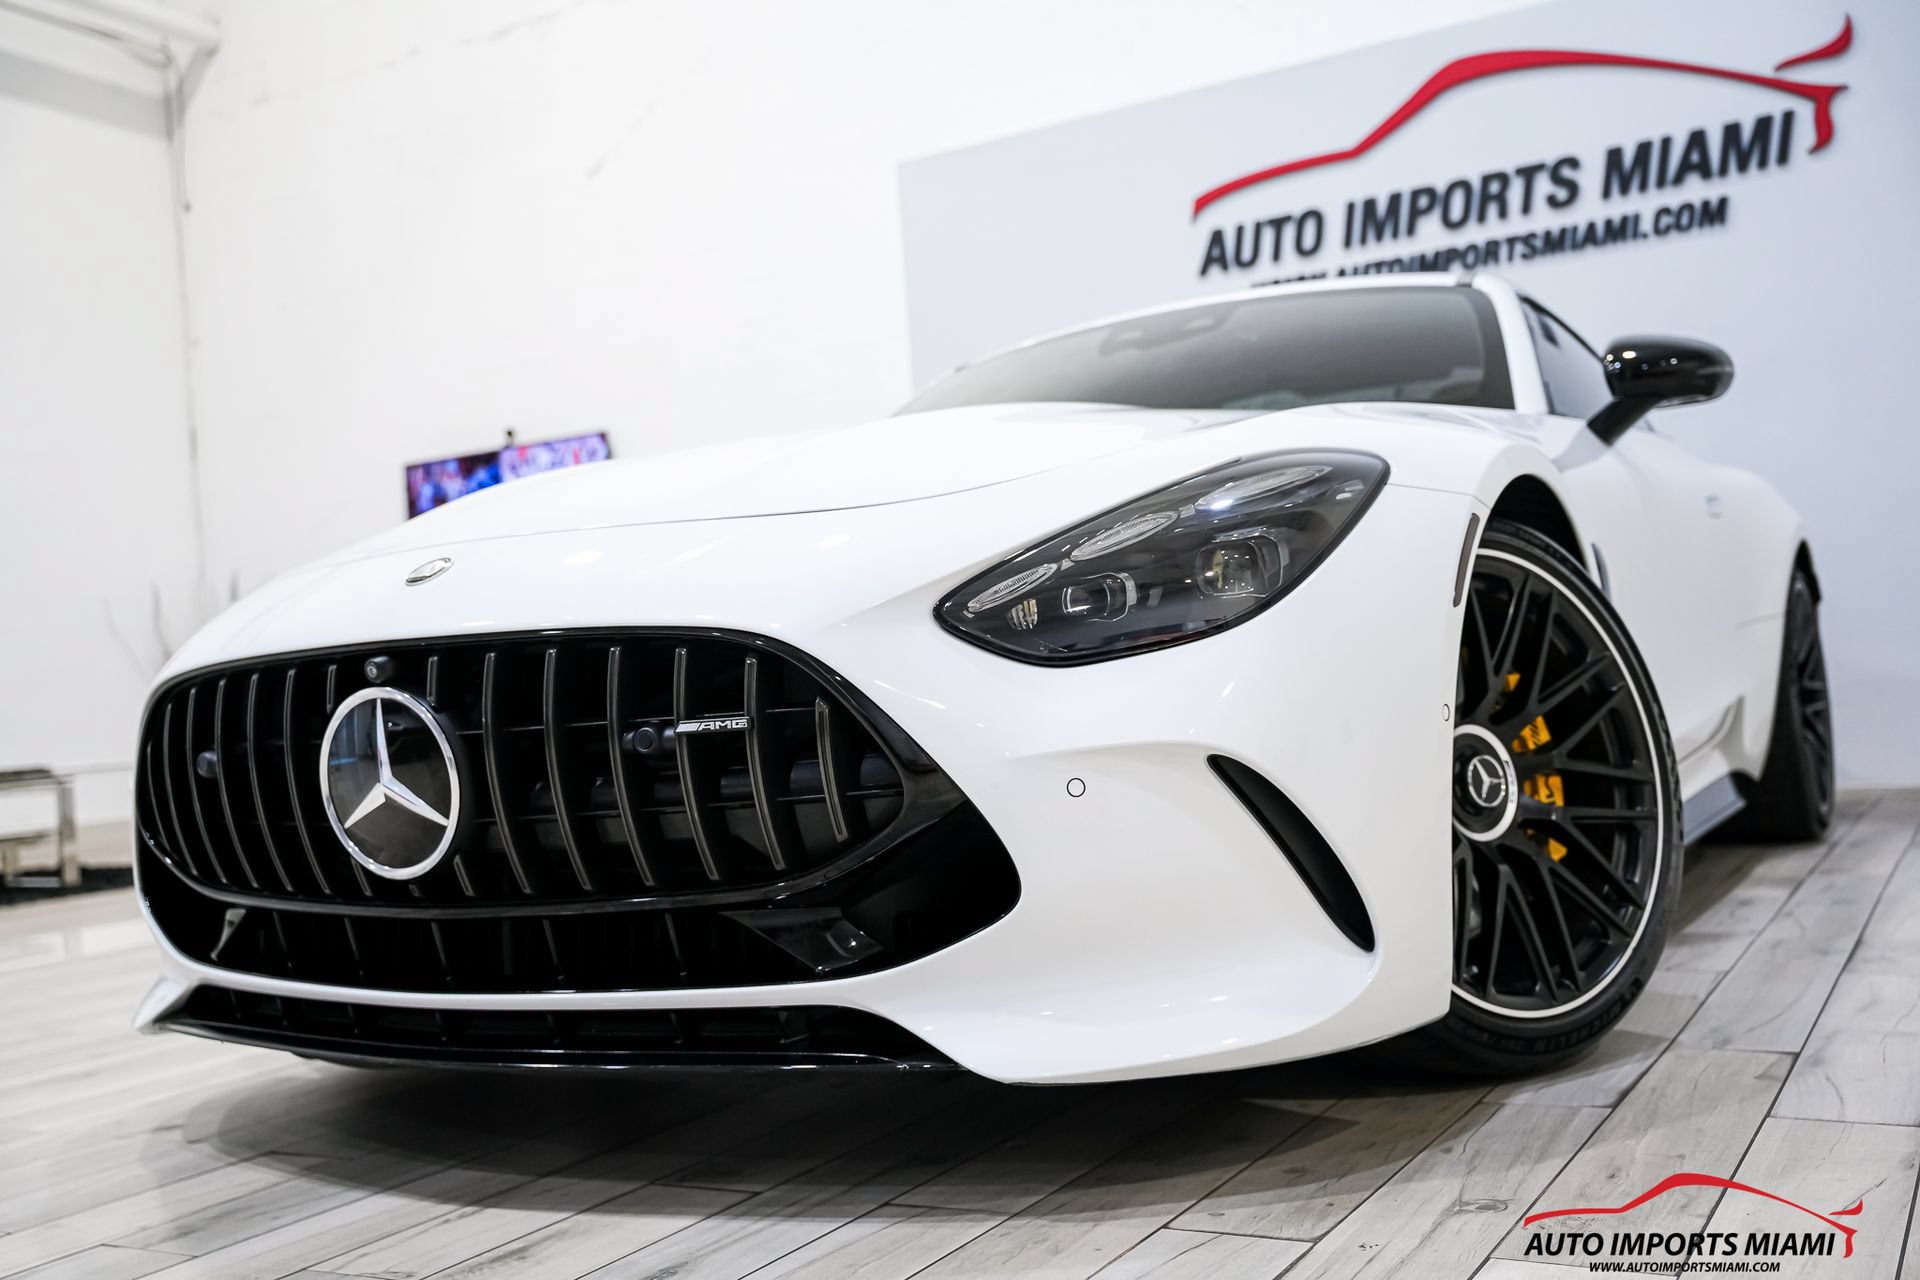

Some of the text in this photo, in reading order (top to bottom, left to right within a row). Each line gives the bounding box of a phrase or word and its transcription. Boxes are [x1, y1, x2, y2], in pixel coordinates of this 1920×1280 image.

[1200, 109, 1796, 277] AUTO IMPORTS MIAMI
[699, 719, 748, 731] AMG
